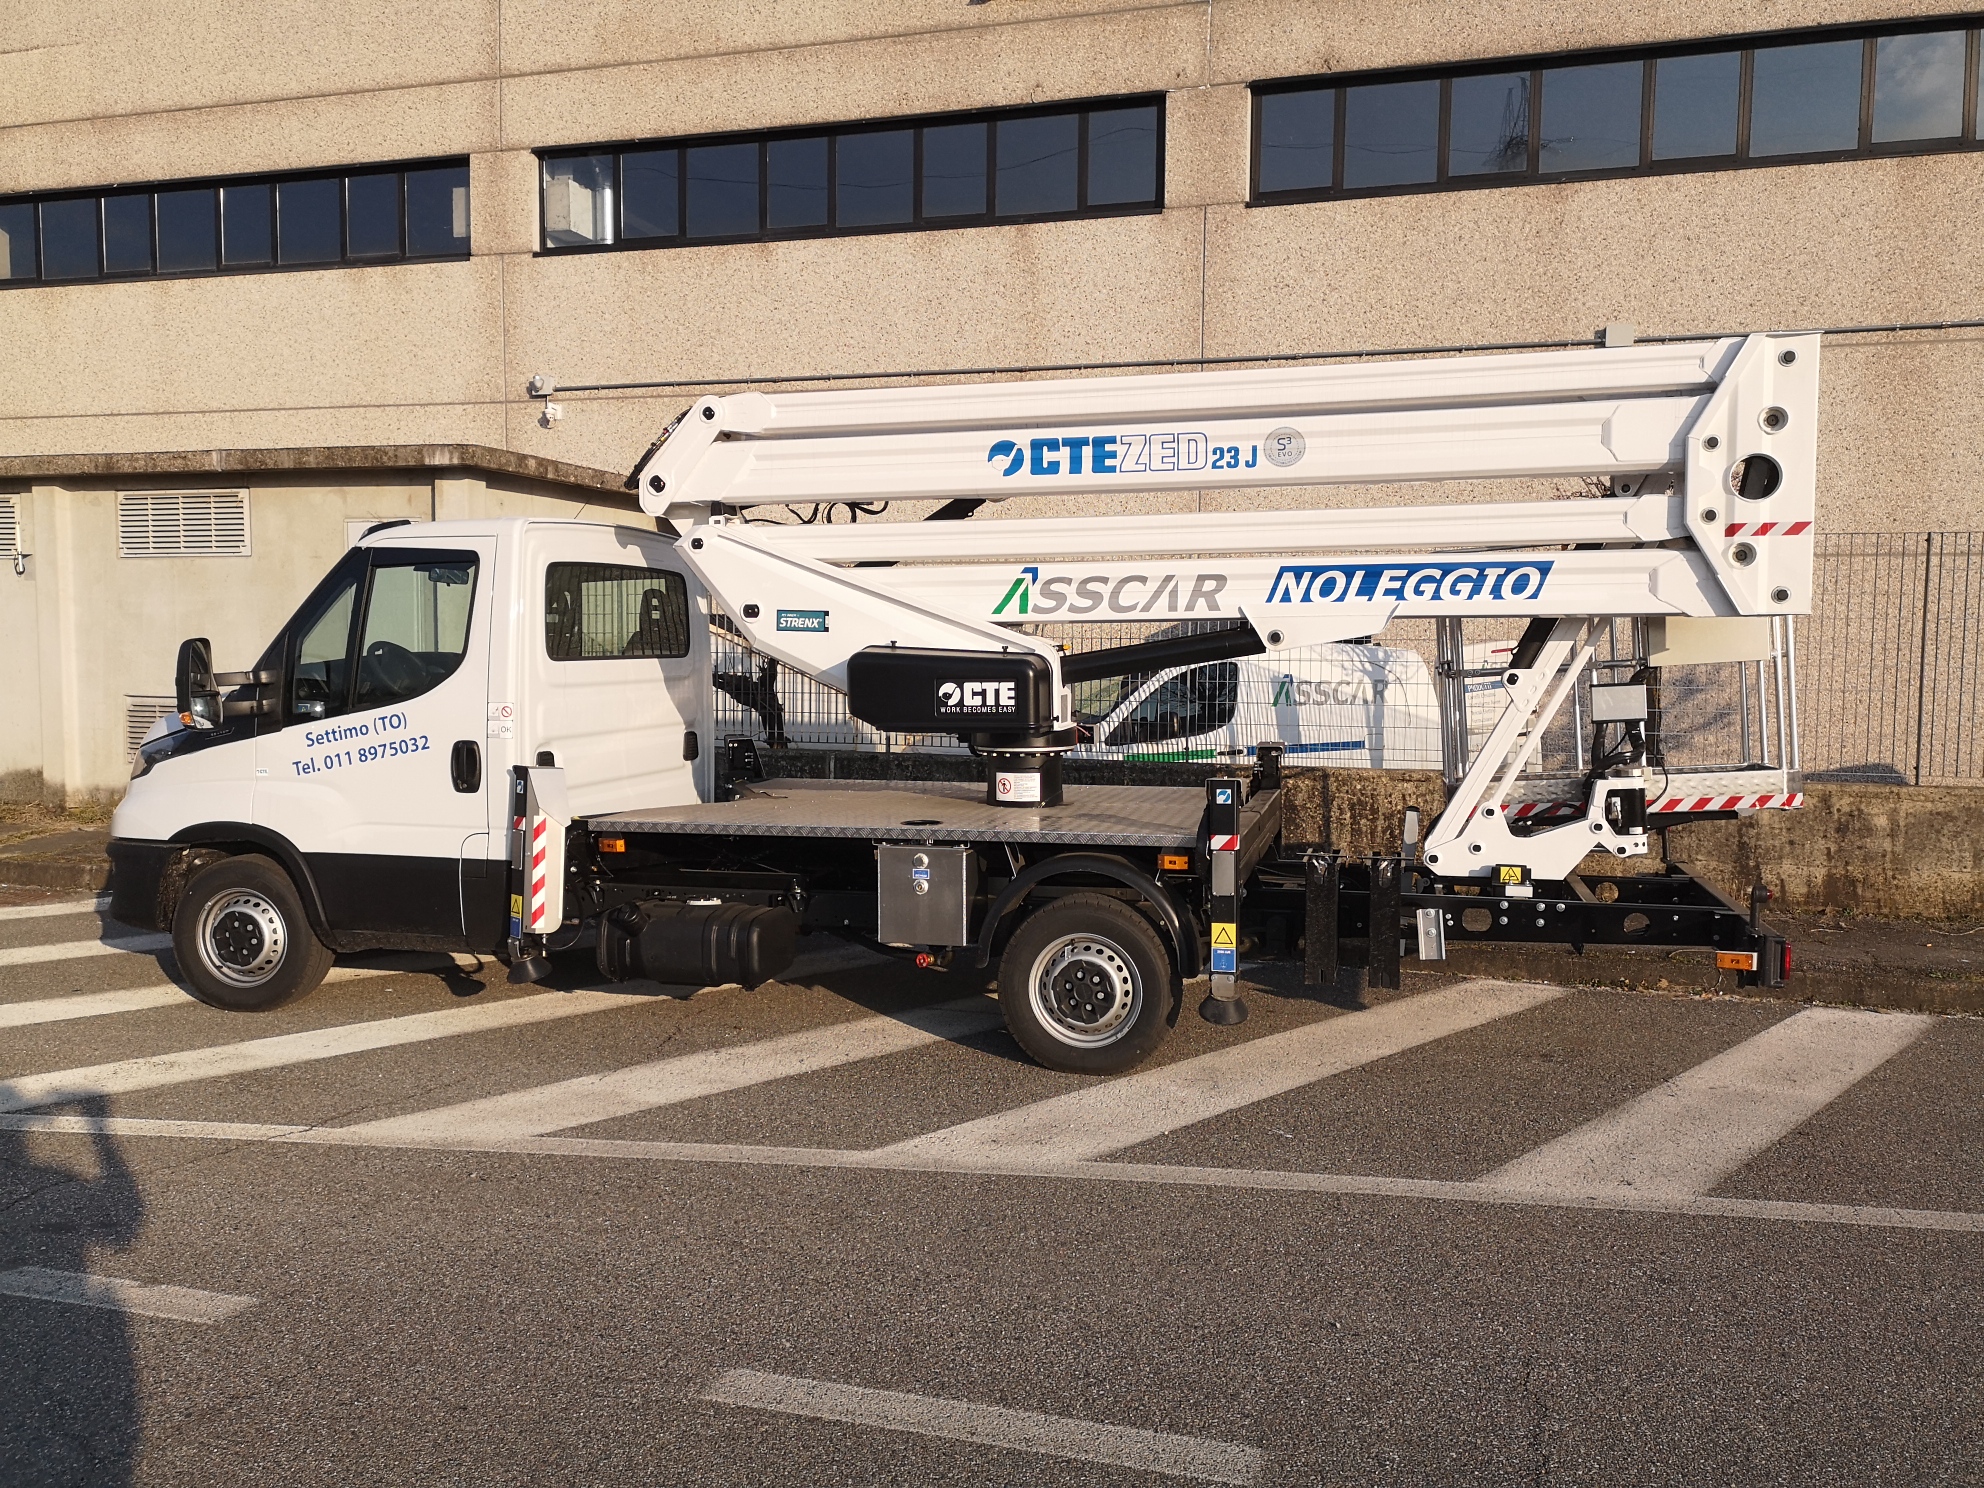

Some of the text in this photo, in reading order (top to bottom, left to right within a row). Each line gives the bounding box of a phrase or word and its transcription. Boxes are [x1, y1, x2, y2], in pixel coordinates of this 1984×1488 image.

[1211, 446, 1239, 470] 23
[1244, 445, 1258, 469] J
[1277, 450, 1293, 458] EVO
[991, 567, 1228, 615] ASSCAR
[1268, 565, 1543, 604] NOLEGGIO
[779, 617, 819, 628] STRENX
[963, 681, 1015, 706] CTE
[1271, 674, 1388, 707] ASSCAR
[305, 711, 408, 748] Settimo (TO)
[292, 735, 431, 776] Tel. 011 8975032
